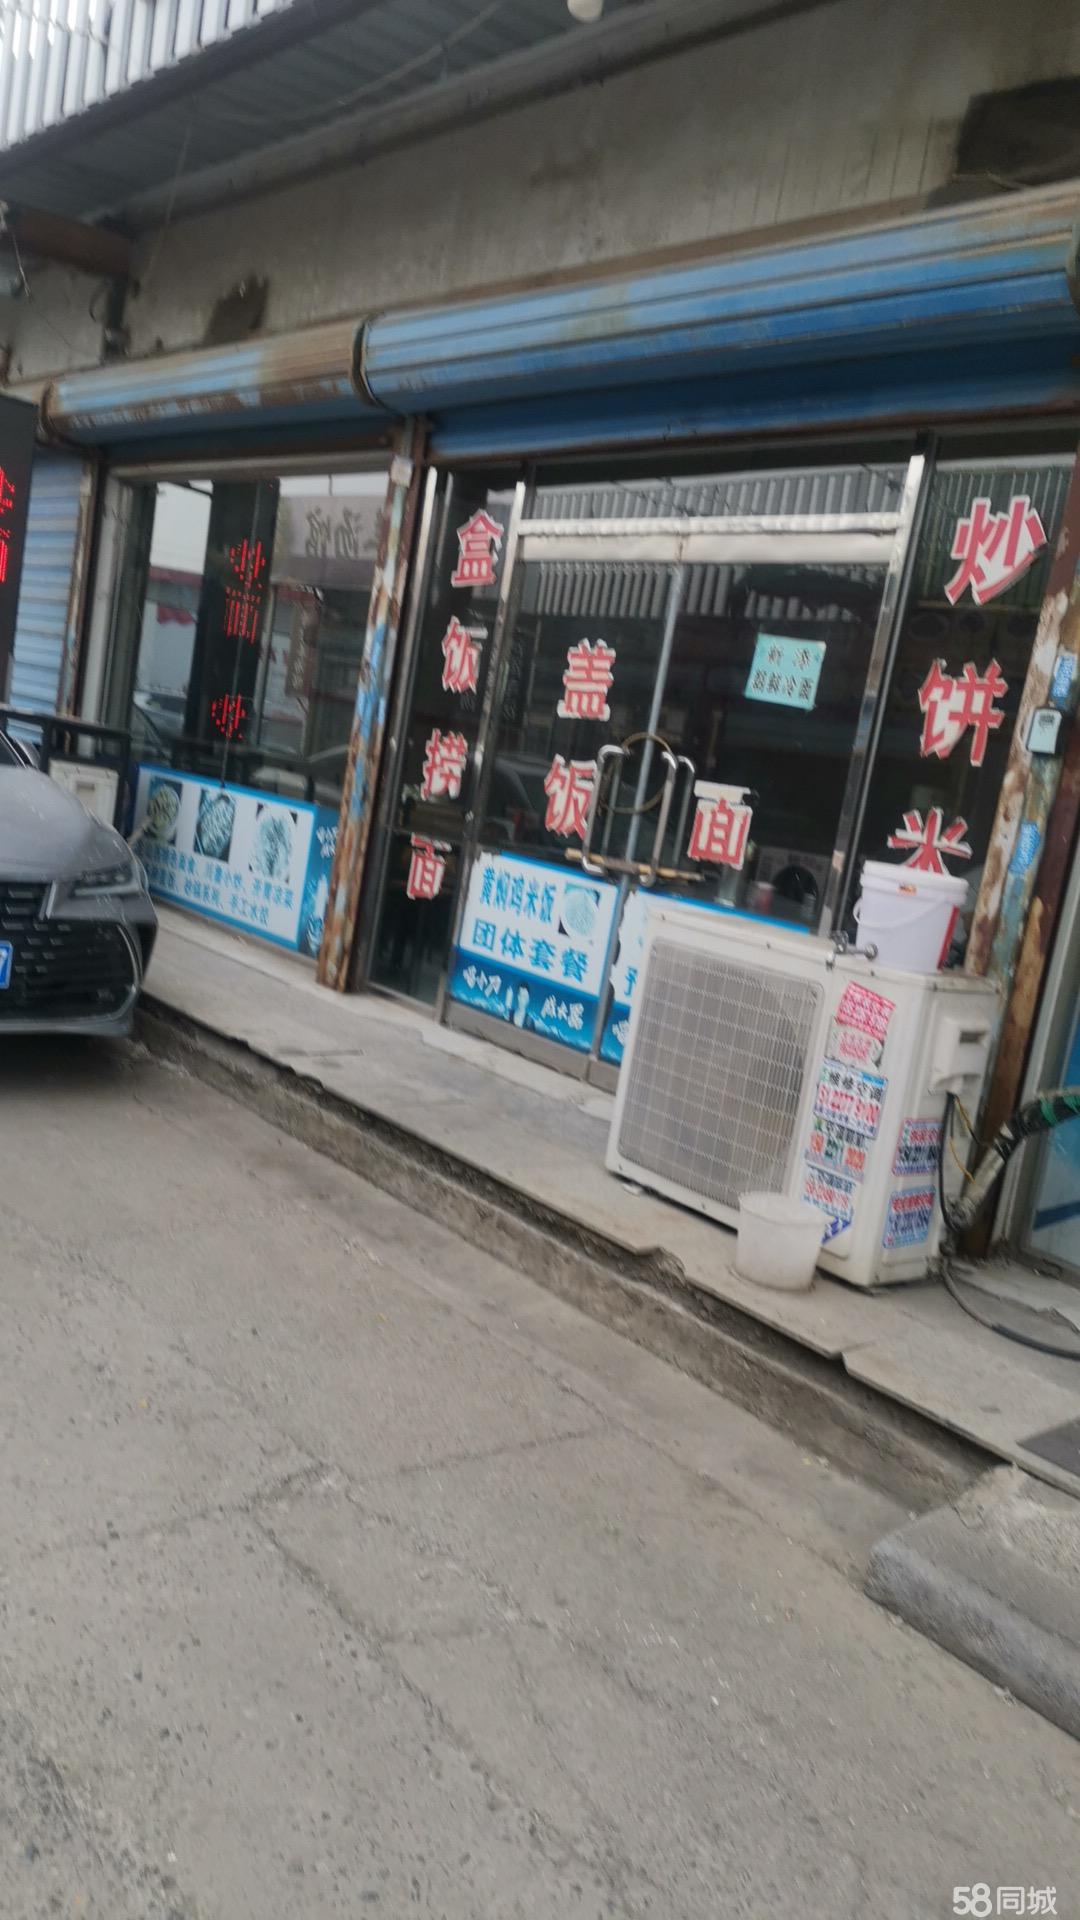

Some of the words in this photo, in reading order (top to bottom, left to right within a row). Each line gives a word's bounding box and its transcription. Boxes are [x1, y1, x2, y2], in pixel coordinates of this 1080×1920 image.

[543, 637, 617, 841] 盖饭
[472, 918, 588, 983] 团体套餐
